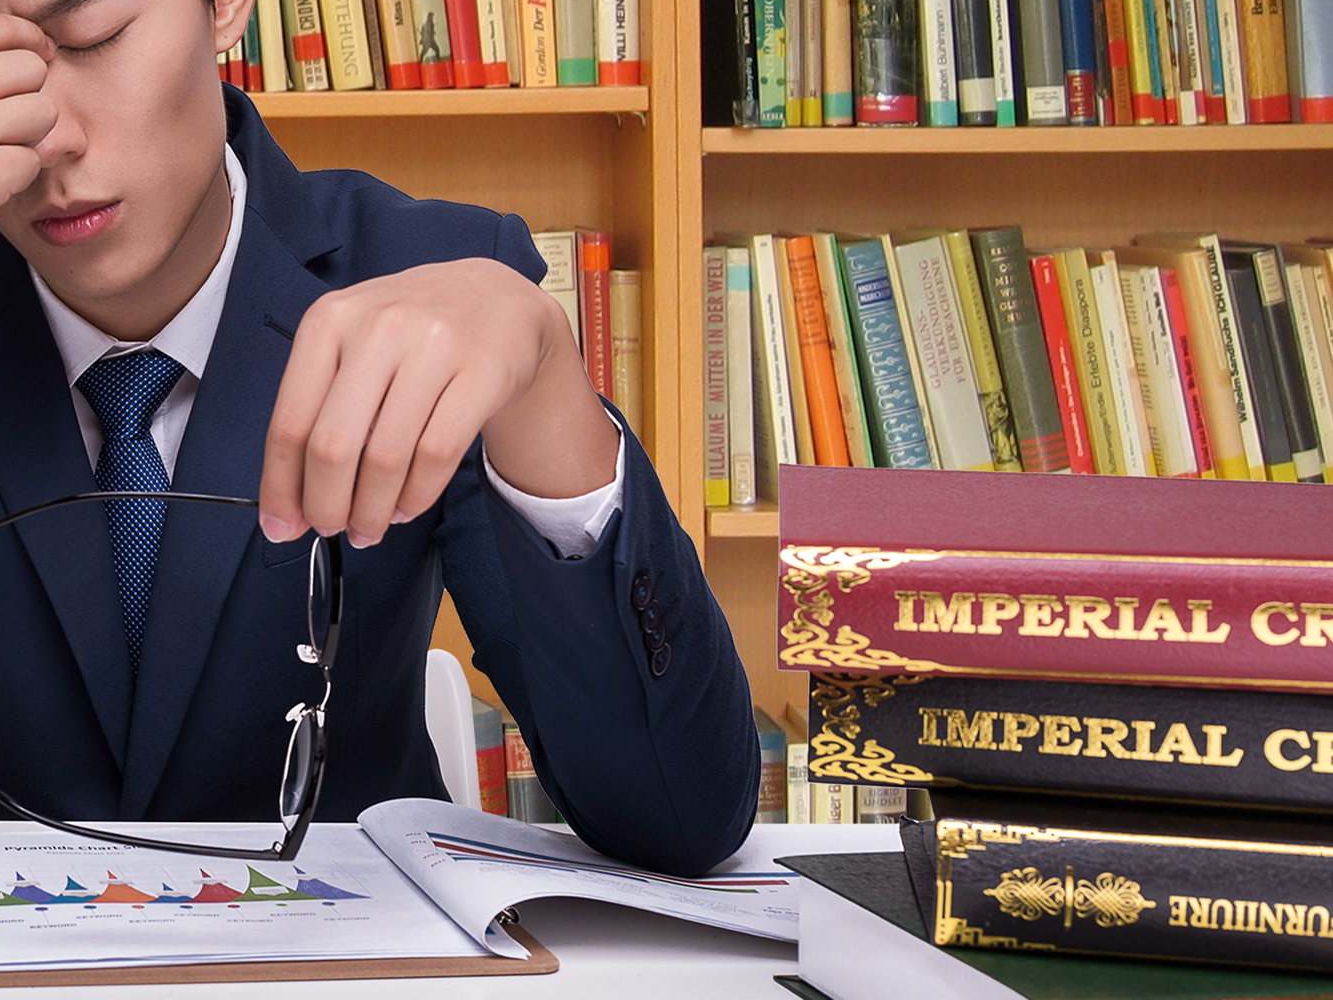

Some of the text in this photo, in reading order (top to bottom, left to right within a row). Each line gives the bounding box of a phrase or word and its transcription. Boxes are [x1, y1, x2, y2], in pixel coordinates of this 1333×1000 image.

[393, 1, 406, 26] Miss
[532, 8, 546, 32] Der
[740, 4, 749, 14] in
[741, 16, 752, 45] Komm
[706, 254, 723, 292] WELT
[707, 296, 724, 323] DER
[918, 258, 950, 376] VERKÜNDIGUNG
[930, 256, 966, 384] FÜR ERWACHSENE
[1073, 279, 1102, 388] Erlebte Diaspora
[1206, 244, 1248, 423] Wilhelm Sandfuchs ICH GLAUBE
[708, 329, 724, 344] IN
[918, 310, 943, 390] GLAUBENS-
[708, 349, 724, 402] MITTEN
[892, 590, 1232, 645] IMPERIAL
[916, 705, 1245, 770] IMPERIAL
